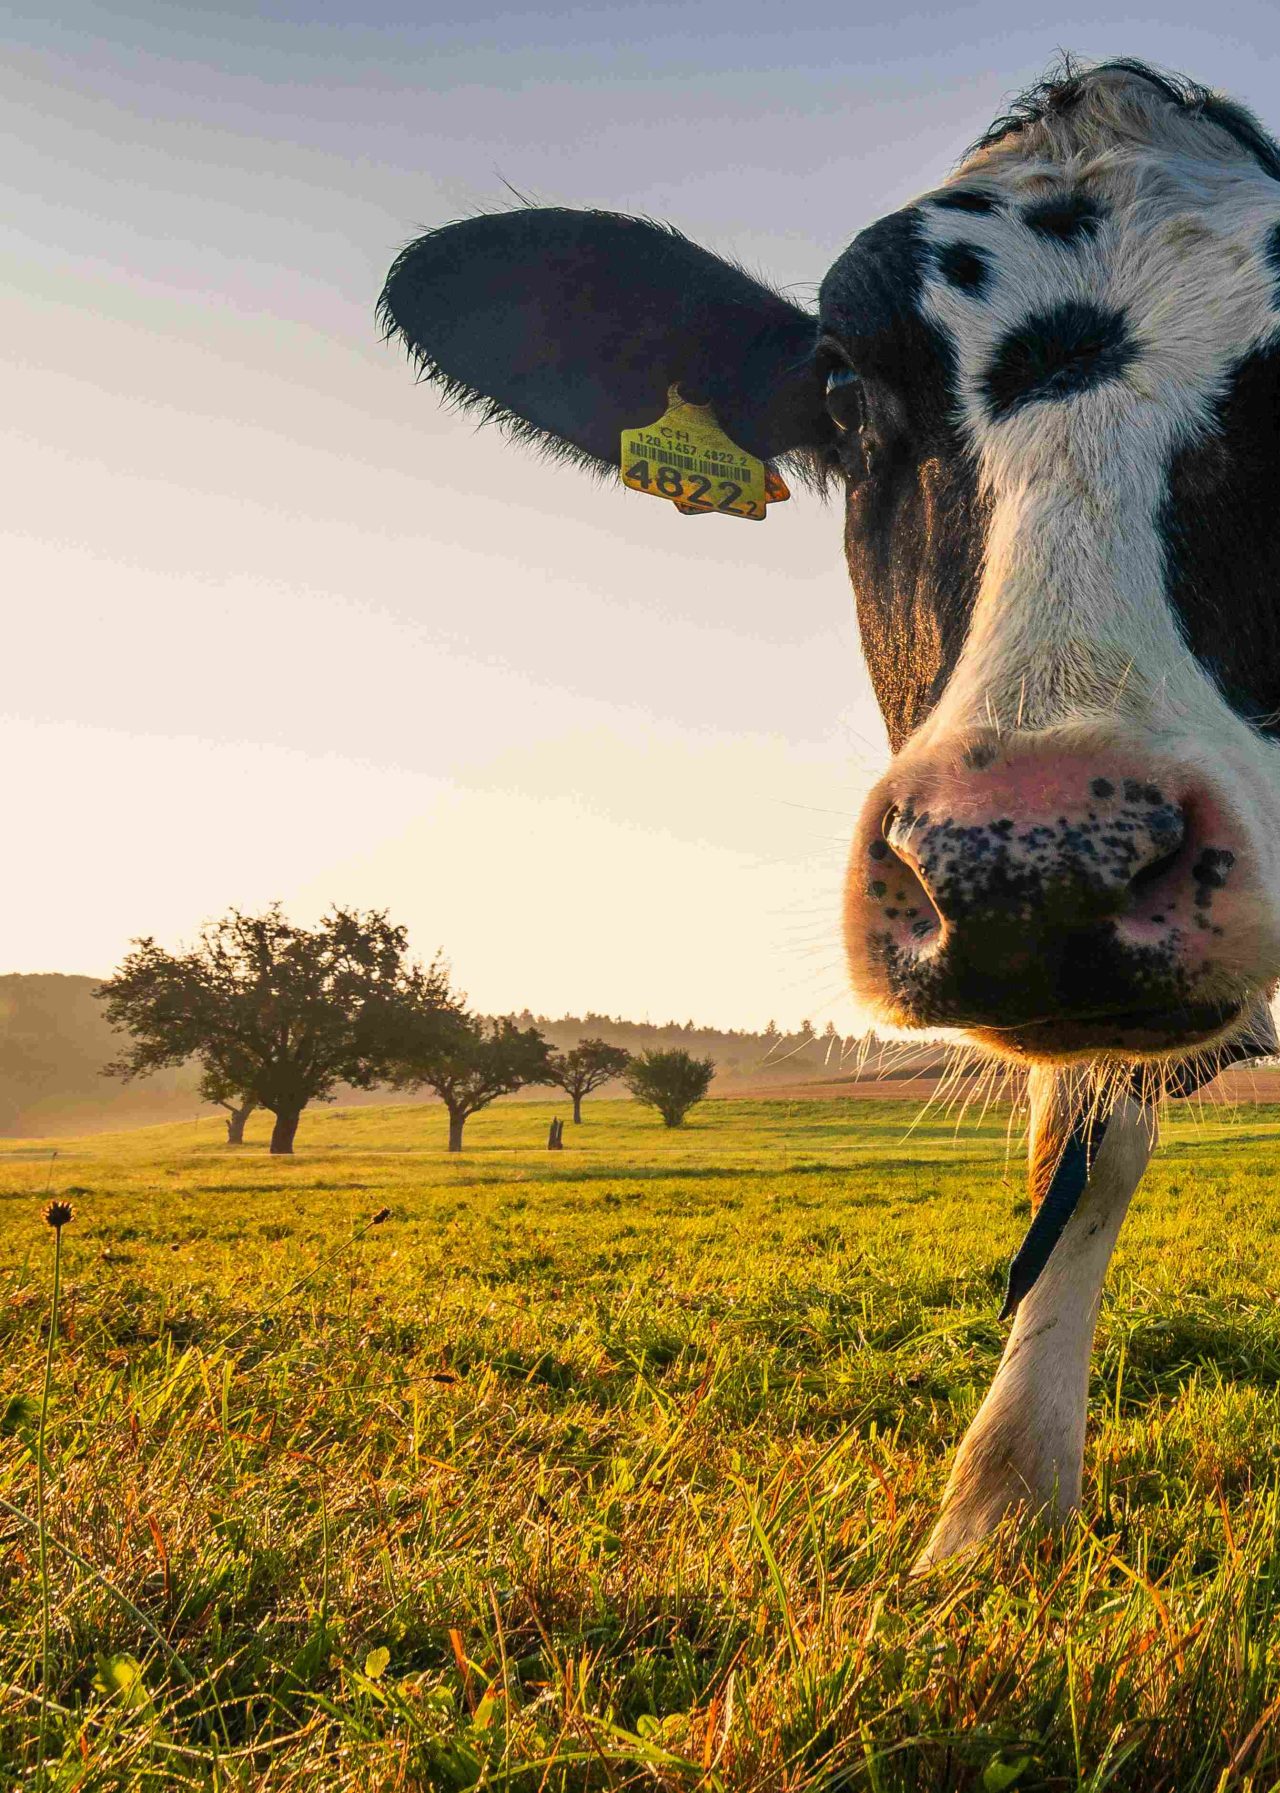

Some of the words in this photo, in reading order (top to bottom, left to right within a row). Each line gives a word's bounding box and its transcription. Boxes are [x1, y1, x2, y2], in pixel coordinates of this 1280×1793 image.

[660, 426, 689, 443] CH
[625, 459, 744, 514] 4822
[746, 500, 759, 517] 2
